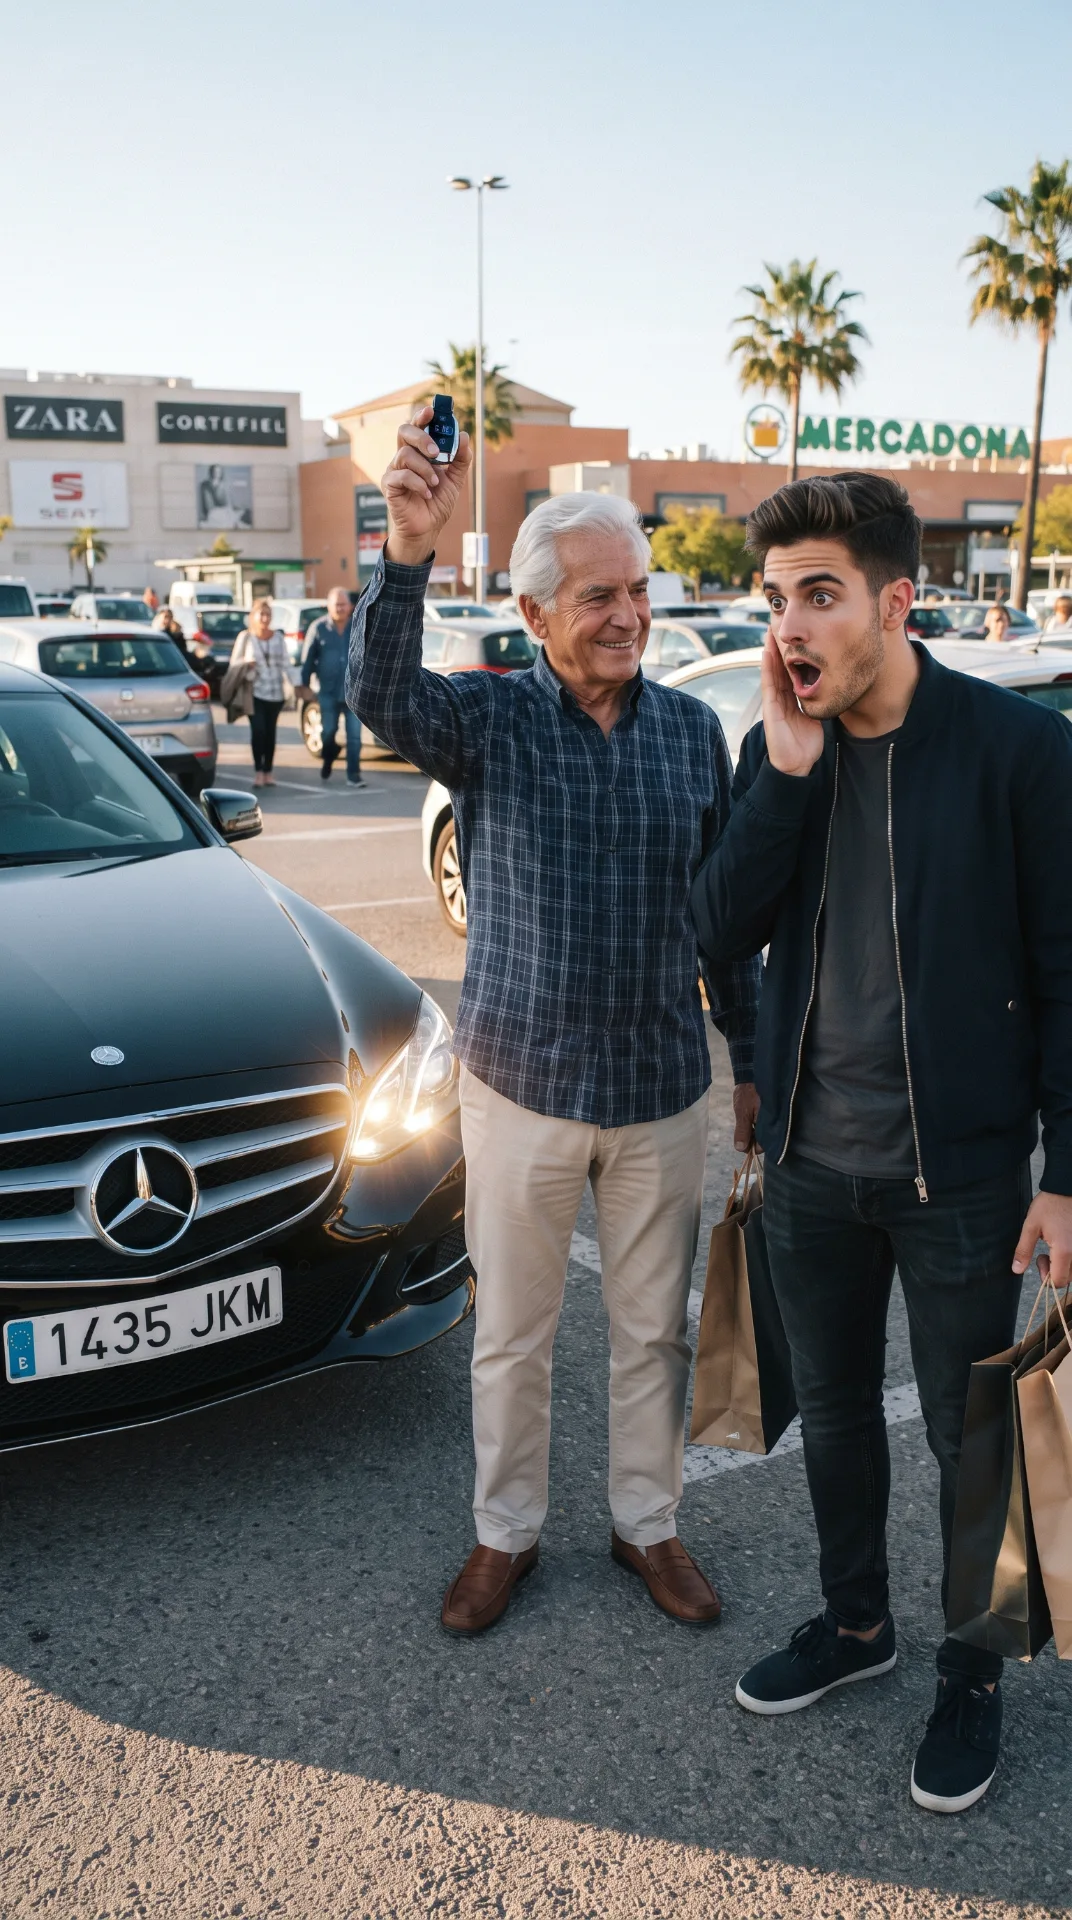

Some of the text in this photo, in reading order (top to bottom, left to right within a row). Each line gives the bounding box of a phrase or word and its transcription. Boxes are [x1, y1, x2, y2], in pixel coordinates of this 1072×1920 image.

[14, 405, 117, 433] ZARA
[160, 414, 286, 434] CORTEFIEL
[797, 416, 1031, 459] MERCADONA
[40, 508, 100, 520] SEAT
[51, 1277, 271, 1365] 1435 JKM
[18, 1357, 29, 1370] E
